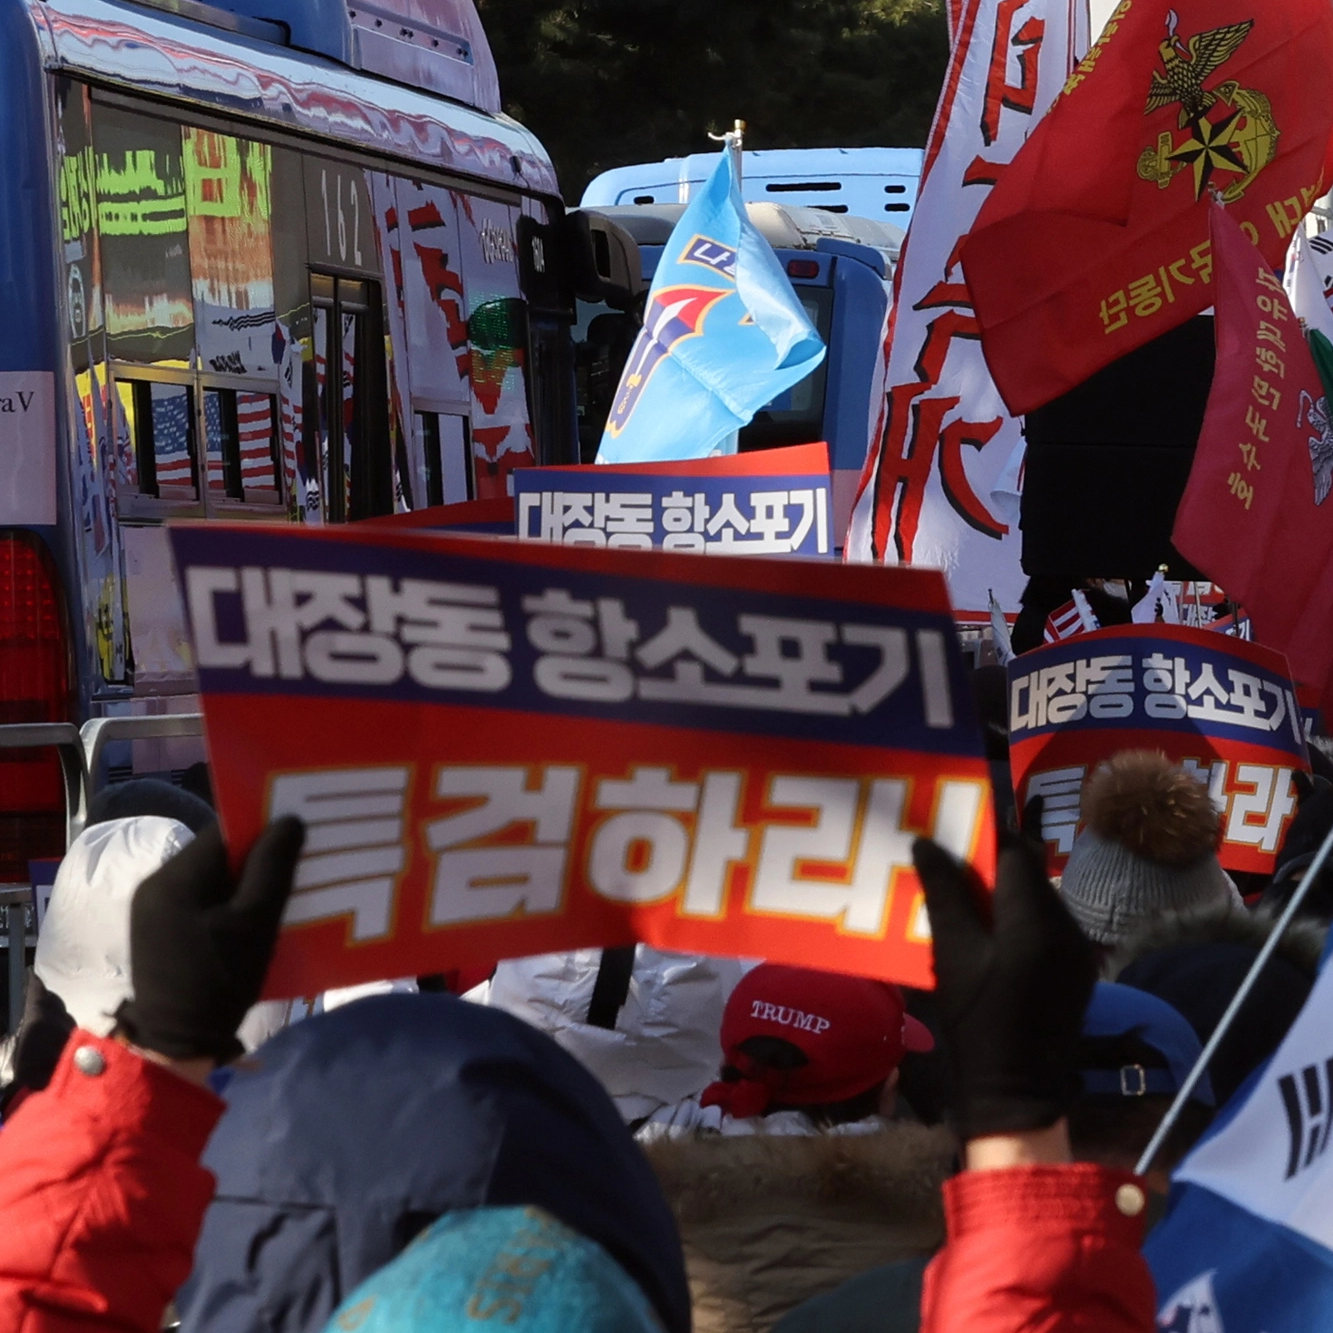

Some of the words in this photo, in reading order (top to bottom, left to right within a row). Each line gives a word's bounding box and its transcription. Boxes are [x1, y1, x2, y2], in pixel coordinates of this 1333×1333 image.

[662, 488, 829, 555] 항소포기
[185, 567, 511, 685] 대장동
[526, 589, 954, 727] 항소포기
[1011, 655, 1135, 732] 대장동
[1143, 653, 1302, 745] 항소포기
[271, 762, 988, 945] 특검하라!
[751, 1000, 831, 1034] TRUMP
